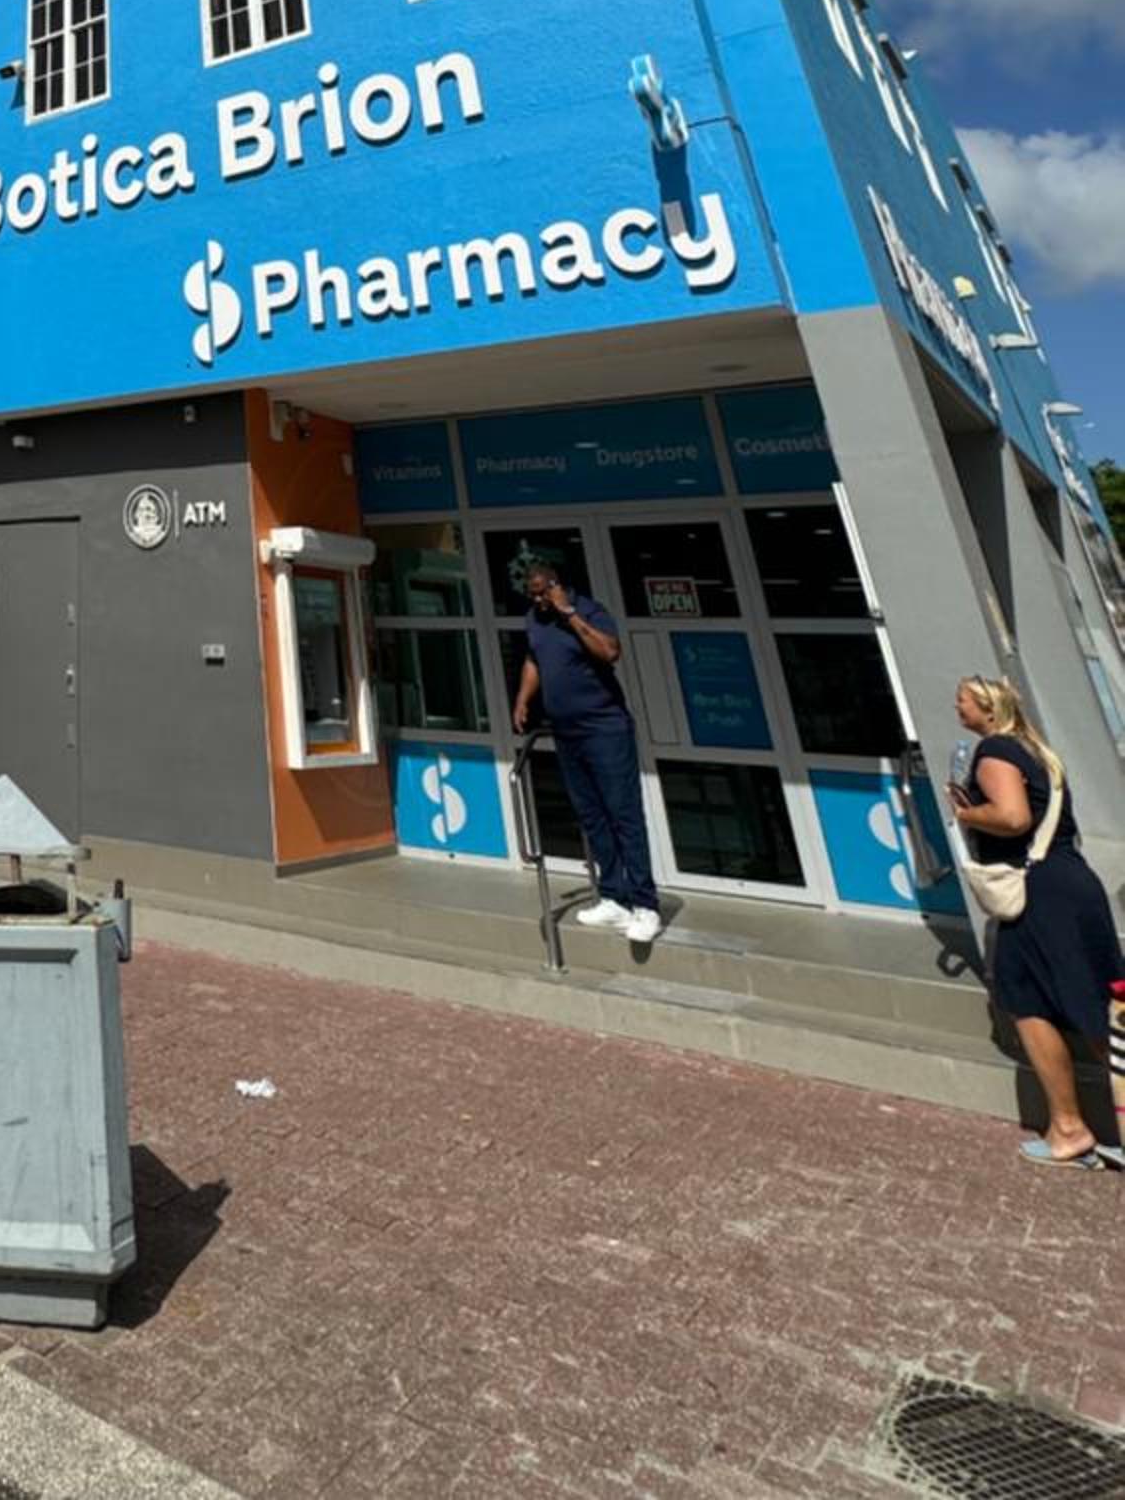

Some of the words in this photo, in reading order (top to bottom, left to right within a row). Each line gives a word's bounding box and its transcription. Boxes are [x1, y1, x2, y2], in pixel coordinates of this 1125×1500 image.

[216, 51, 485, 179] Brion
[251, 192, 737, 336] Pharmacy
[373, 464, 442, 482] Vitamins
[476, 453, 567, 475] Pharmacy
[596, 443, 698, 468] Drugstore
[183, 500, 226, 524] ATM
